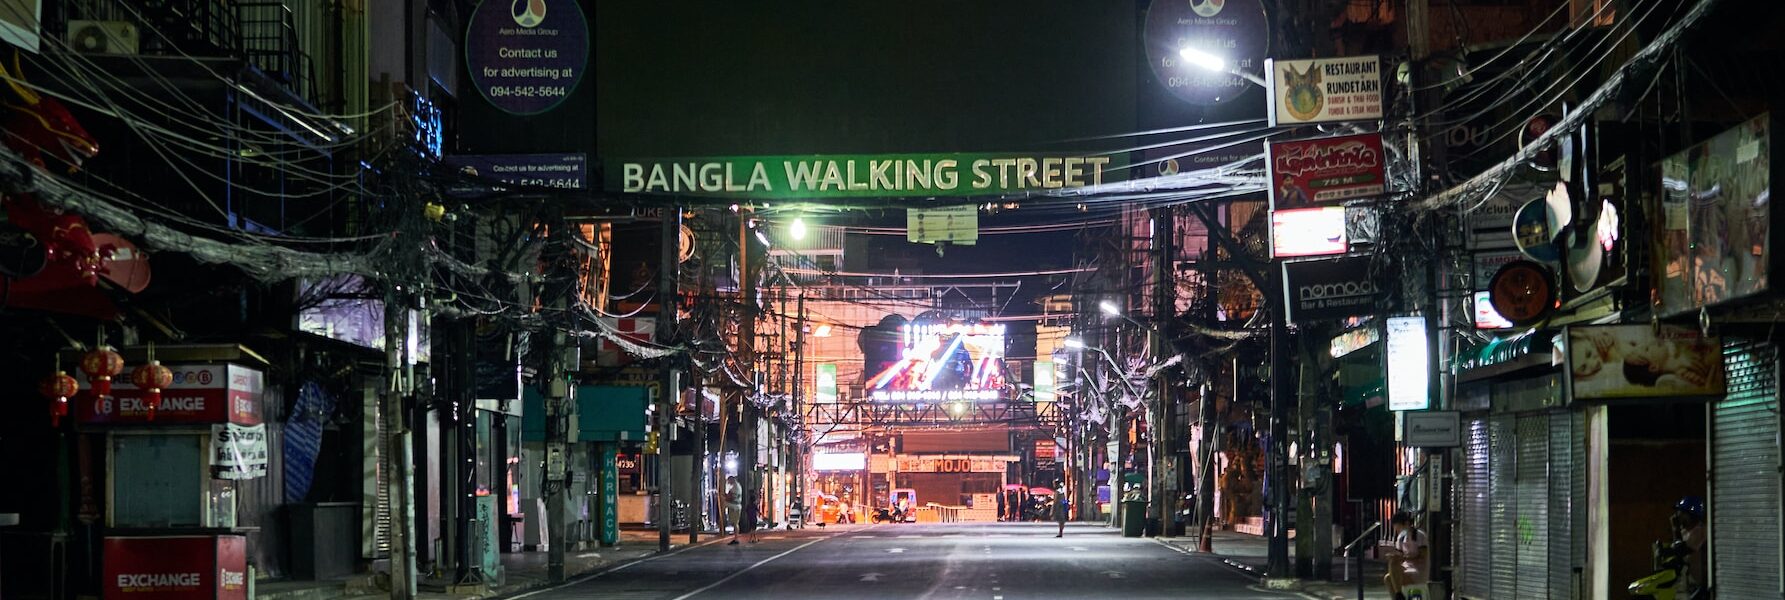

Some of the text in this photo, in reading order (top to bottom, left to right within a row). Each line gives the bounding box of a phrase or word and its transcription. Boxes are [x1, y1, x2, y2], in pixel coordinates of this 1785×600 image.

[499, 47, 557, 58] Contact us
[483, 66, 573, 79] for advertising at
[1325, 61, 1376, 76] RESTAURANT
[490, 86, 566, 97] 094-542-5644
[1366, 93, 1380, 103] FOOD
[528, 164, 536, 172] for
[537, 164, 571, 173] advertising
[623, 156, 1110, 193] BANGLA WALKING STREET
[934, 459, 971, 473] MOJO
[117, 573, 201, 587] EXCHANGE
